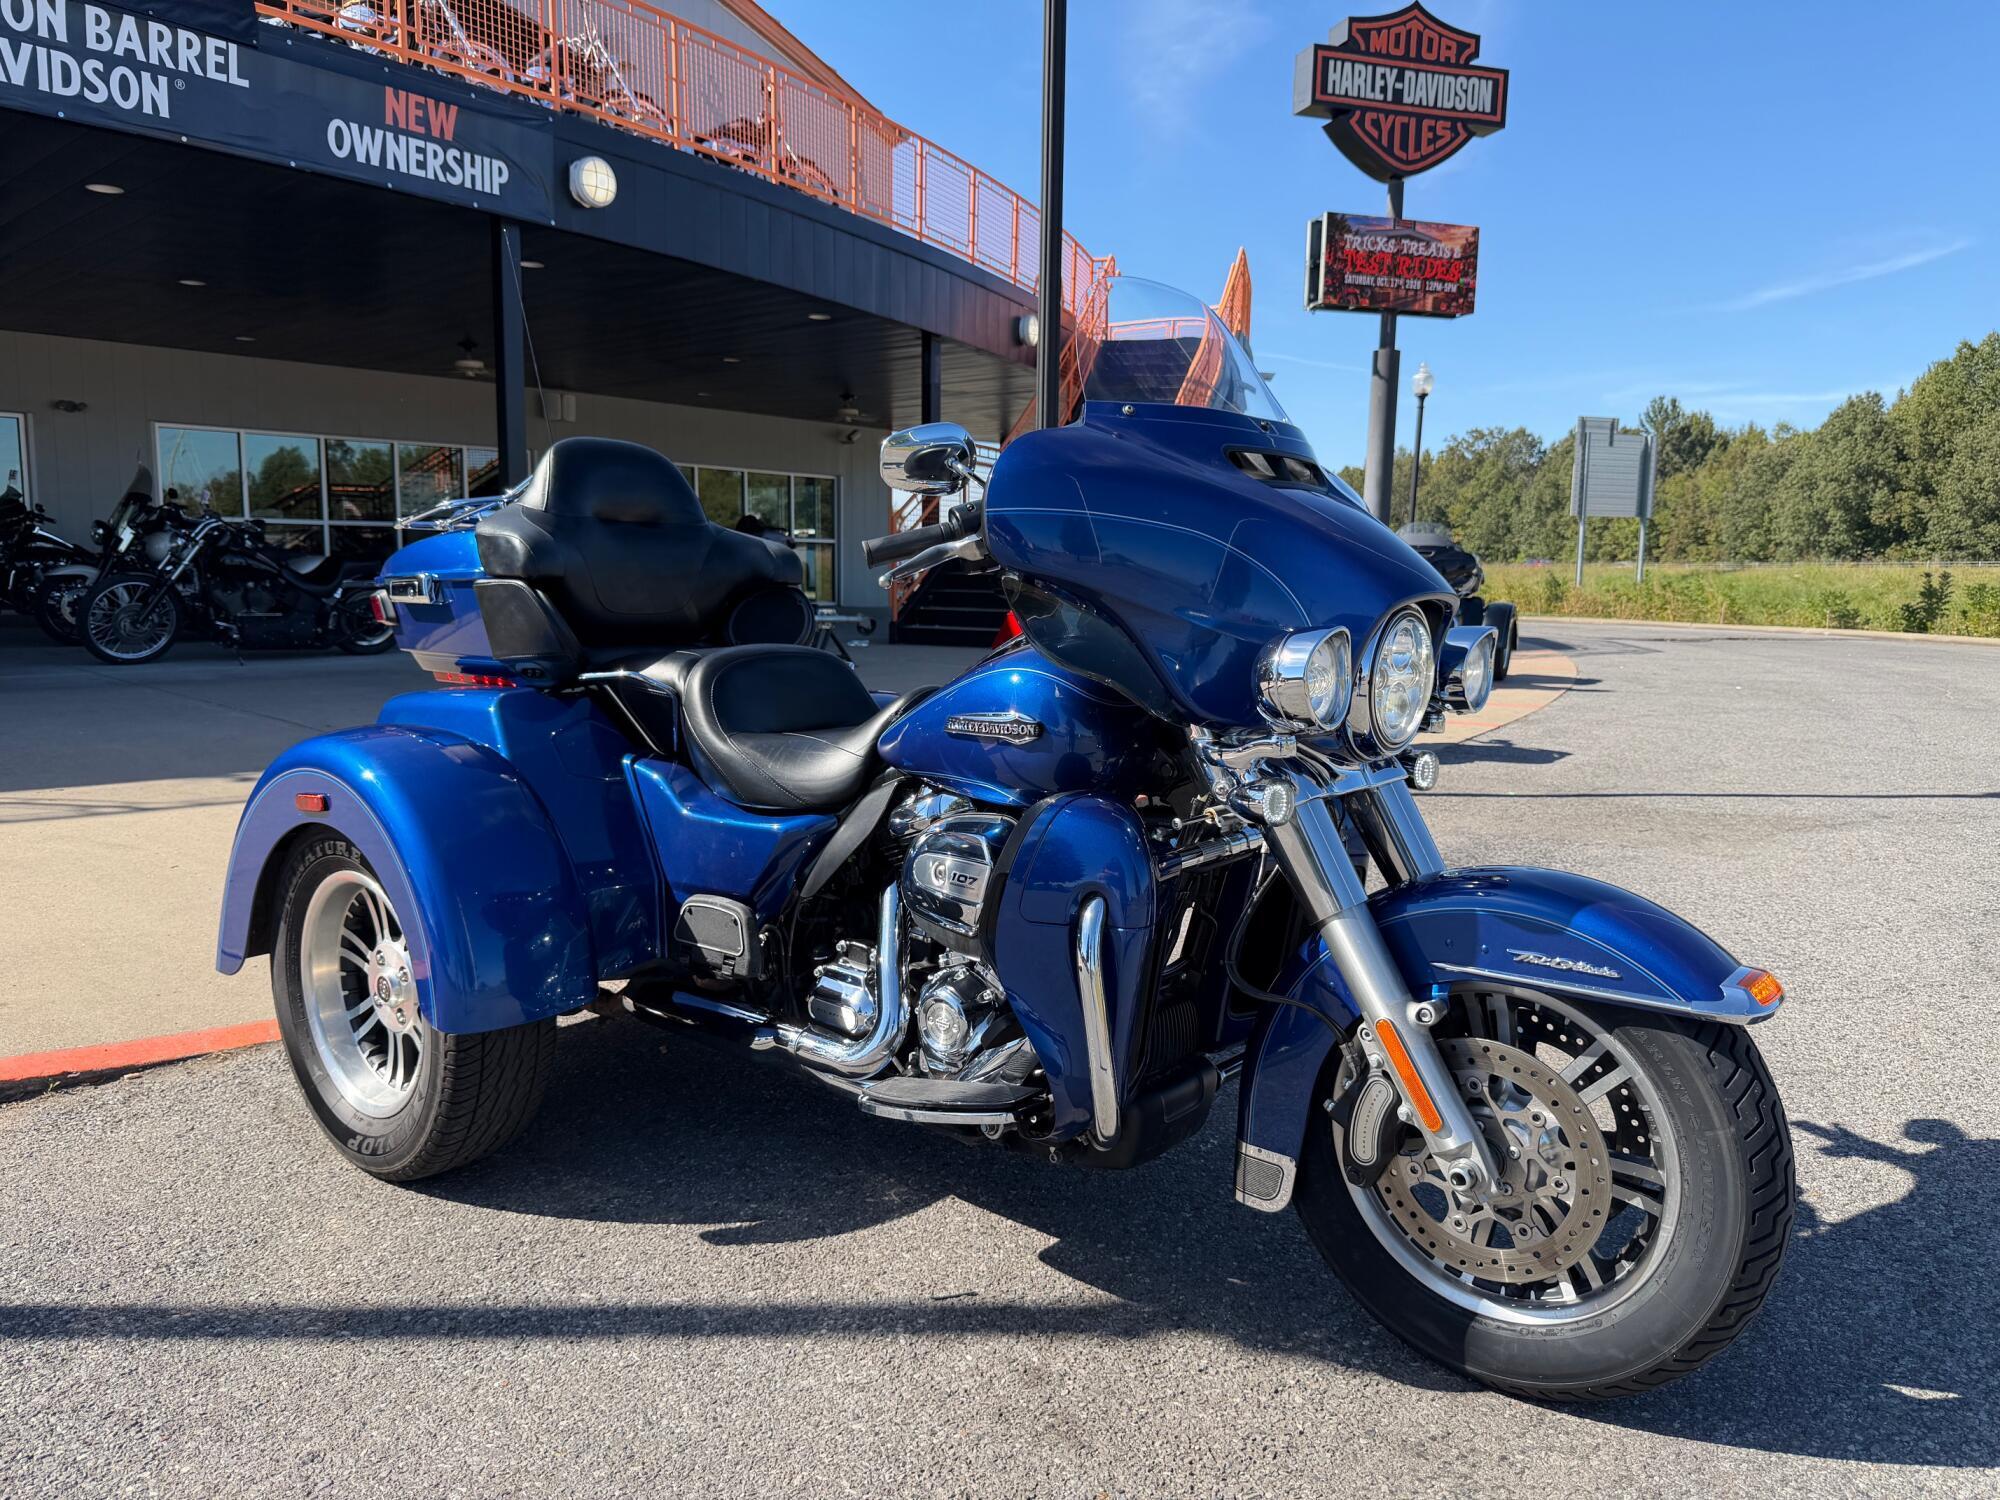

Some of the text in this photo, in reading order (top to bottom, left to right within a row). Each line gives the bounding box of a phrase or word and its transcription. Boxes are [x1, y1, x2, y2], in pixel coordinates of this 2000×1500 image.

[85, 4, 249, 88] BARREL
[1370, 18, 1457, 64] MOTOR
[1327, 59, 1493, 113] HARLEY-DAVIDSON
[385, 86, 458, 141] NEW
[1364, 111, 1454, 161] CYCLES
[327, 118, 509, 195] OWNERSHIP
[1344, 250, 1463, 283] TEST RIDES
[1402, 239, 1450, 258] TREATS
[947, 719, 1036, 736] HARLEY-DAVIDSON
[950, 872, 978, 886] 107
